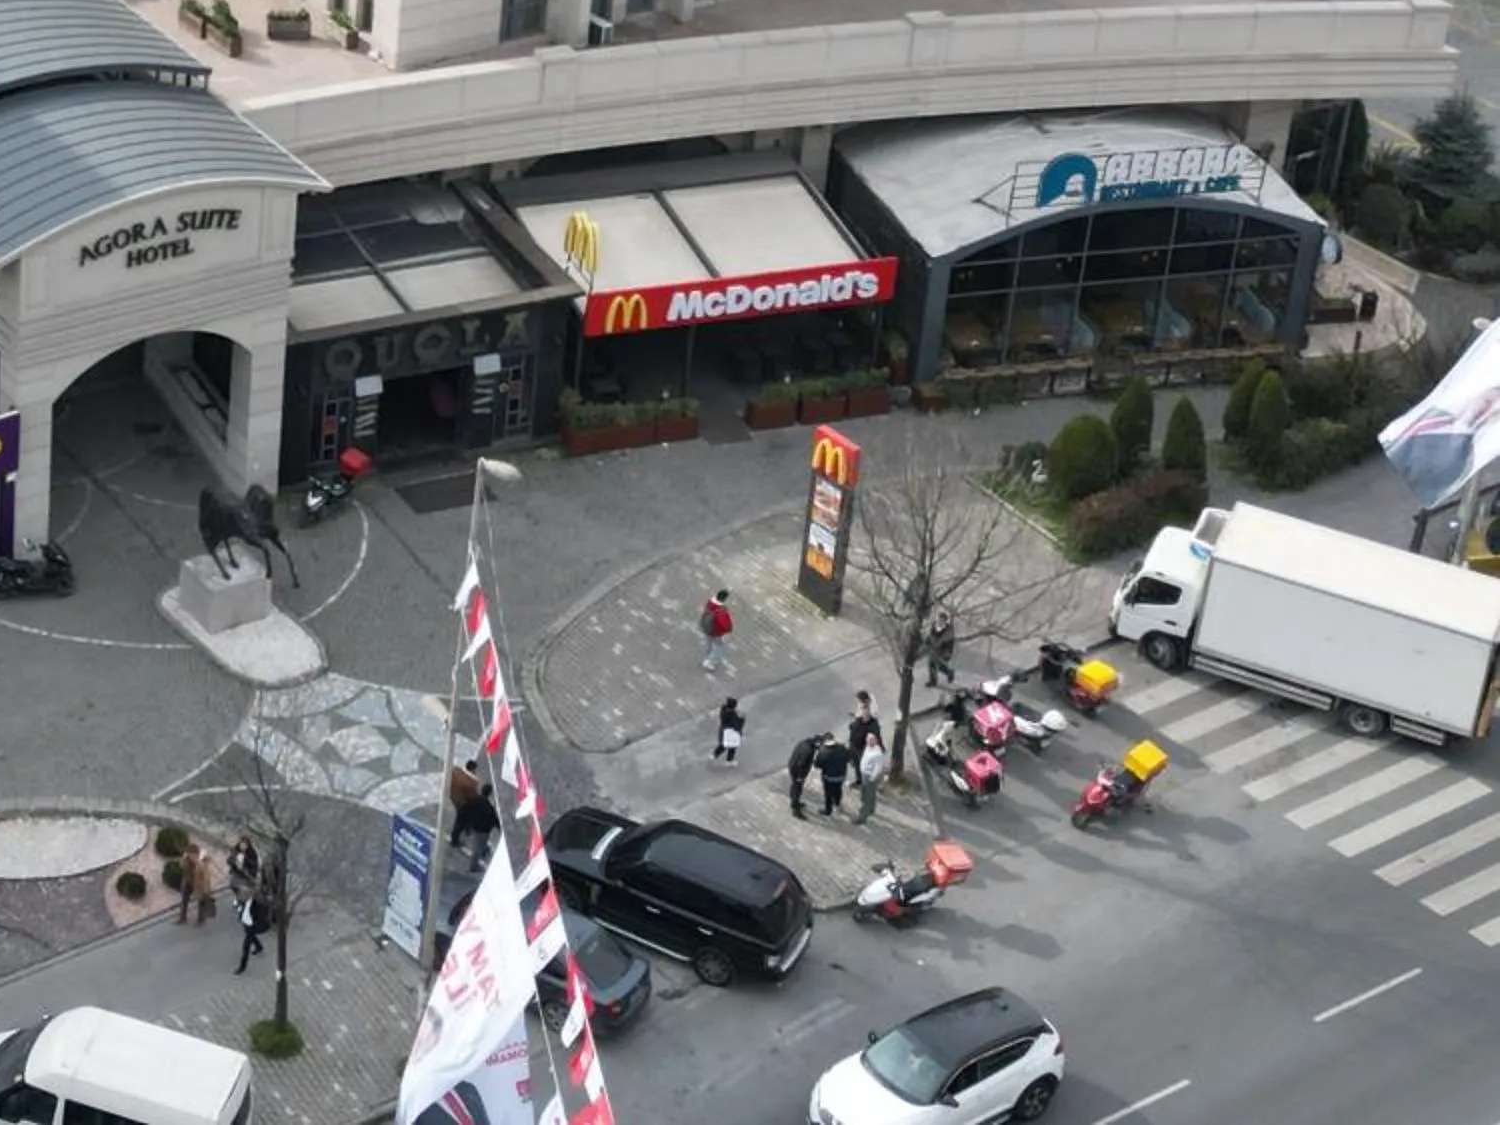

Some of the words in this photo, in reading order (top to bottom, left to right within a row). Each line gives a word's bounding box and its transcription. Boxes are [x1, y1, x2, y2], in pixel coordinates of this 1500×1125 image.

[79, 216, 167, 266] AGORA
[176, 208, 242, 233] SUITE
[125, 237, 194, 269] HOTEL
[666, 271, 878, 322] McDonald's
